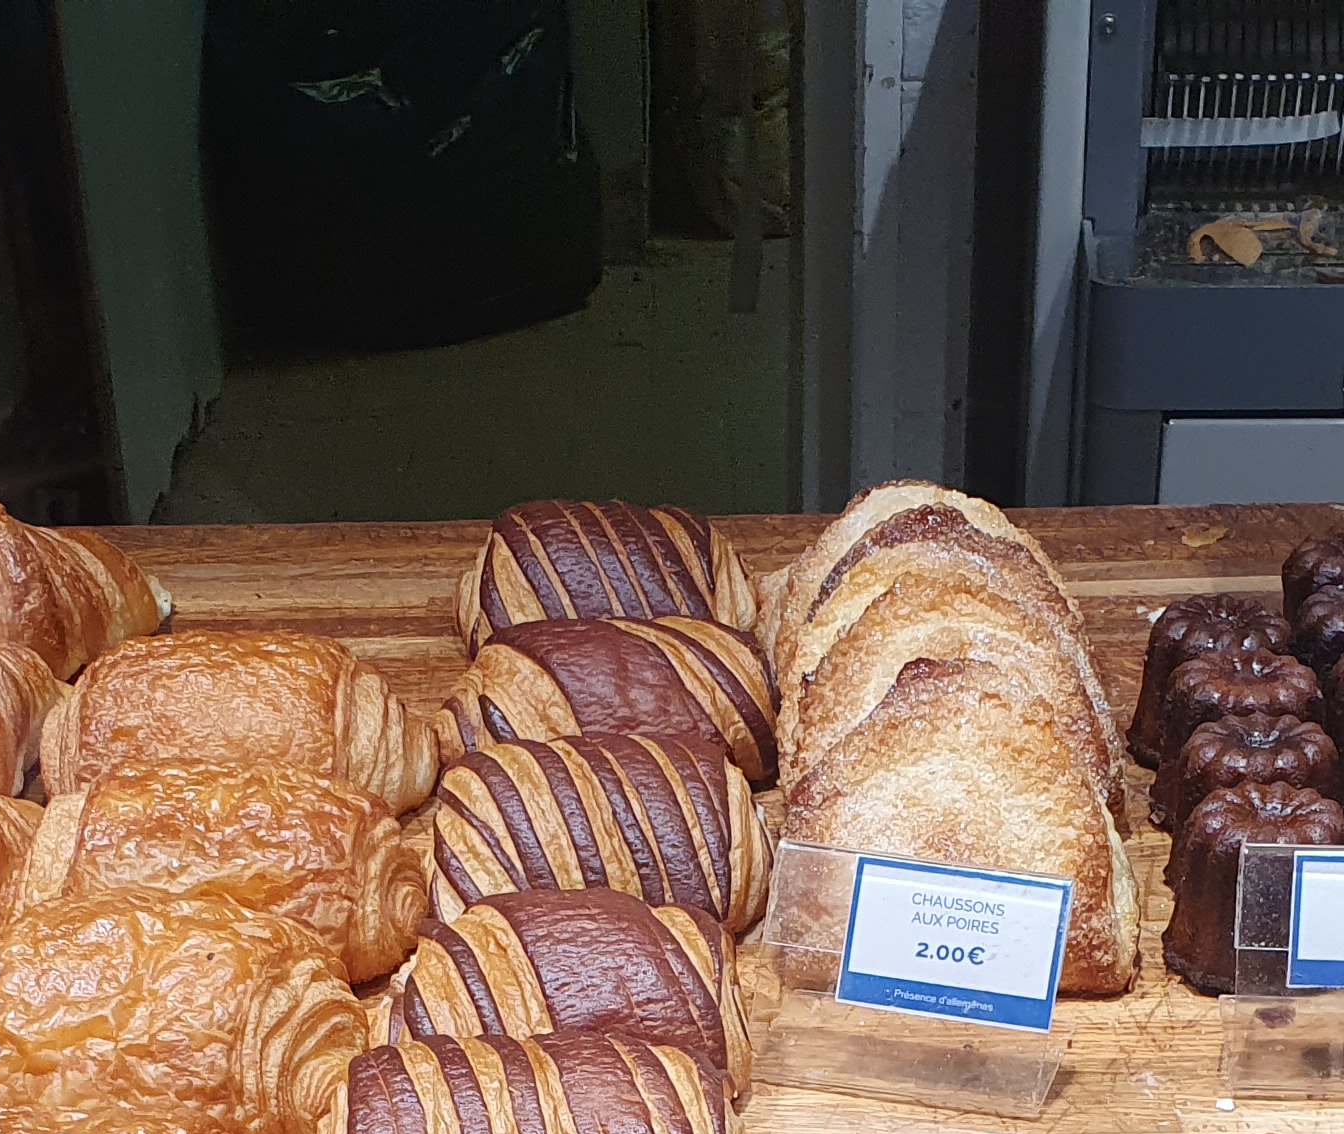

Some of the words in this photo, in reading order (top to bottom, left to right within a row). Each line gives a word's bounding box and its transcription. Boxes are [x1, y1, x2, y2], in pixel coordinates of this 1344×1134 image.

[911, 891, 1006, 917] CHAUSSONS
[910, 911, 944, 928] AUX
[946, 915, 1000, 935] POIRES
[914, 941, 986, 966] 2.00€
